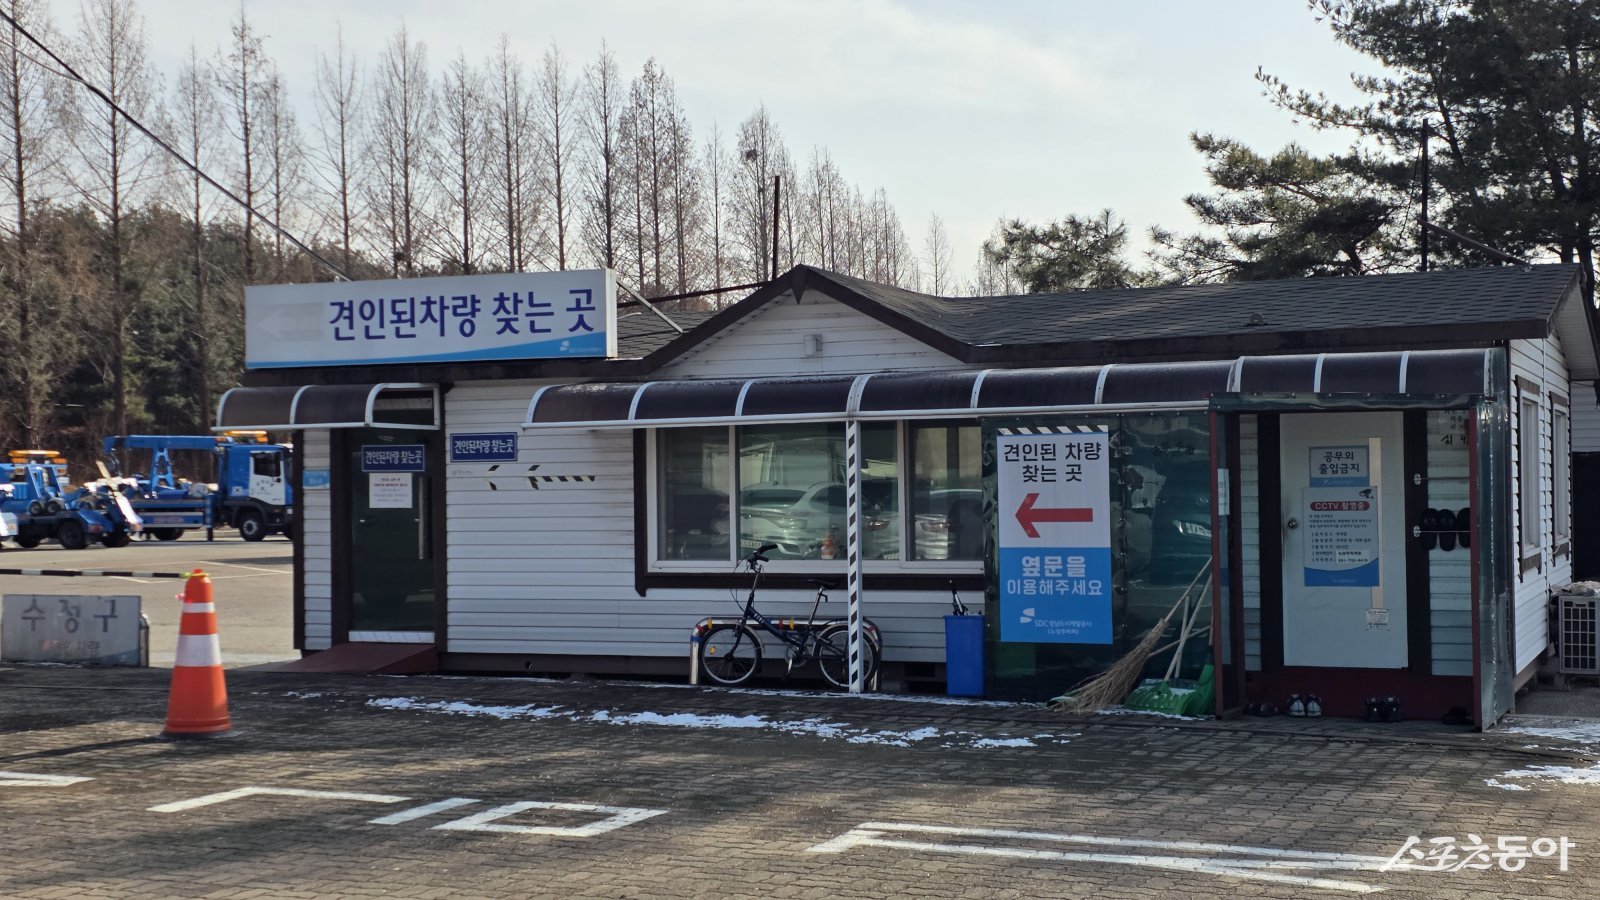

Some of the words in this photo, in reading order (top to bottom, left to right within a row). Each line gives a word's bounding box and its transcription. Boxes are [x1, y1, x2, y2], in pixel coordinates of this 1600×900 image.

[329, 294, 481, 341] 견인된차량
[492, 291, 555, 337] 찾는
[565, 288, 596, 334] 곳
[454, 439, 490, 454] 견인된차량
[1004, 443, 1057, 462] 견인된
[1065, 442, 1101, 461] 차량
[365, 451, 399, 465] 견인된차량
[1324, 451, 1354, 463] 공무외
[1022, 464, 1057, 483] 찾는
[1065, 463, 1082, 482] 곳
[1318, 463, 1360, 475] 출입금지
[1315, 502, 1339, 510] CCTV
[1021, 555, 1086, 577] 옆문을
[1007, 579, 1103, 596] 이용해주세요
[1034, 619, 1048, 627] SDC
